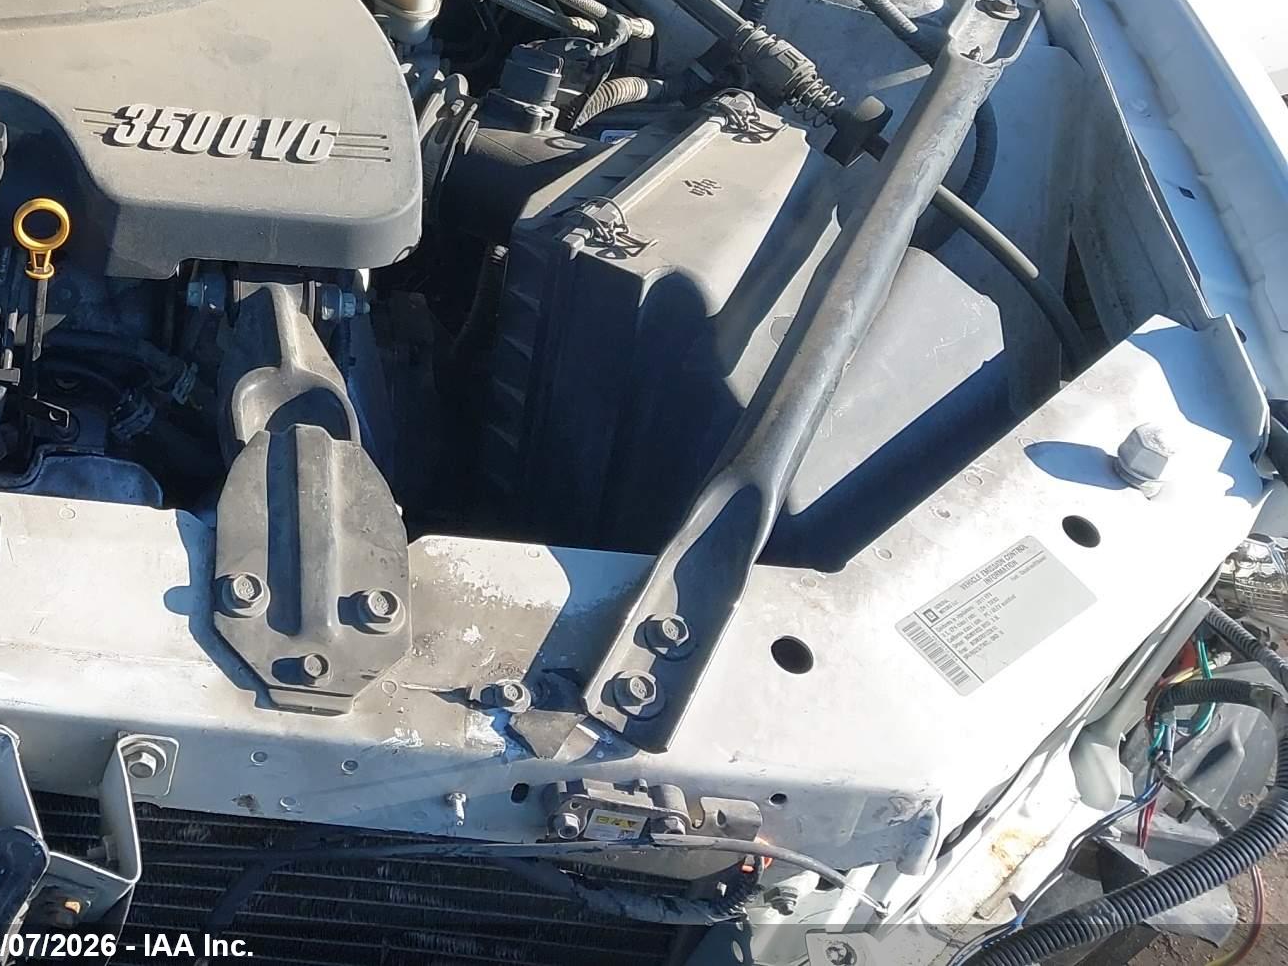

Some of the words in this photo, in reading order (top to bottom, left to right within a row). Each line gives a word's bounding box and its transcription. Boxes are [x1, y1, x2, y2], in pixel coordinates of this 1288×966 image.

[959, 573, 983, 590] VEHICLE
[980, 559, 1007, 575] EMISSION
[1003, 544, 1029, 560] CONTROL
[982, 559, 1018, 585] INFORMATION
